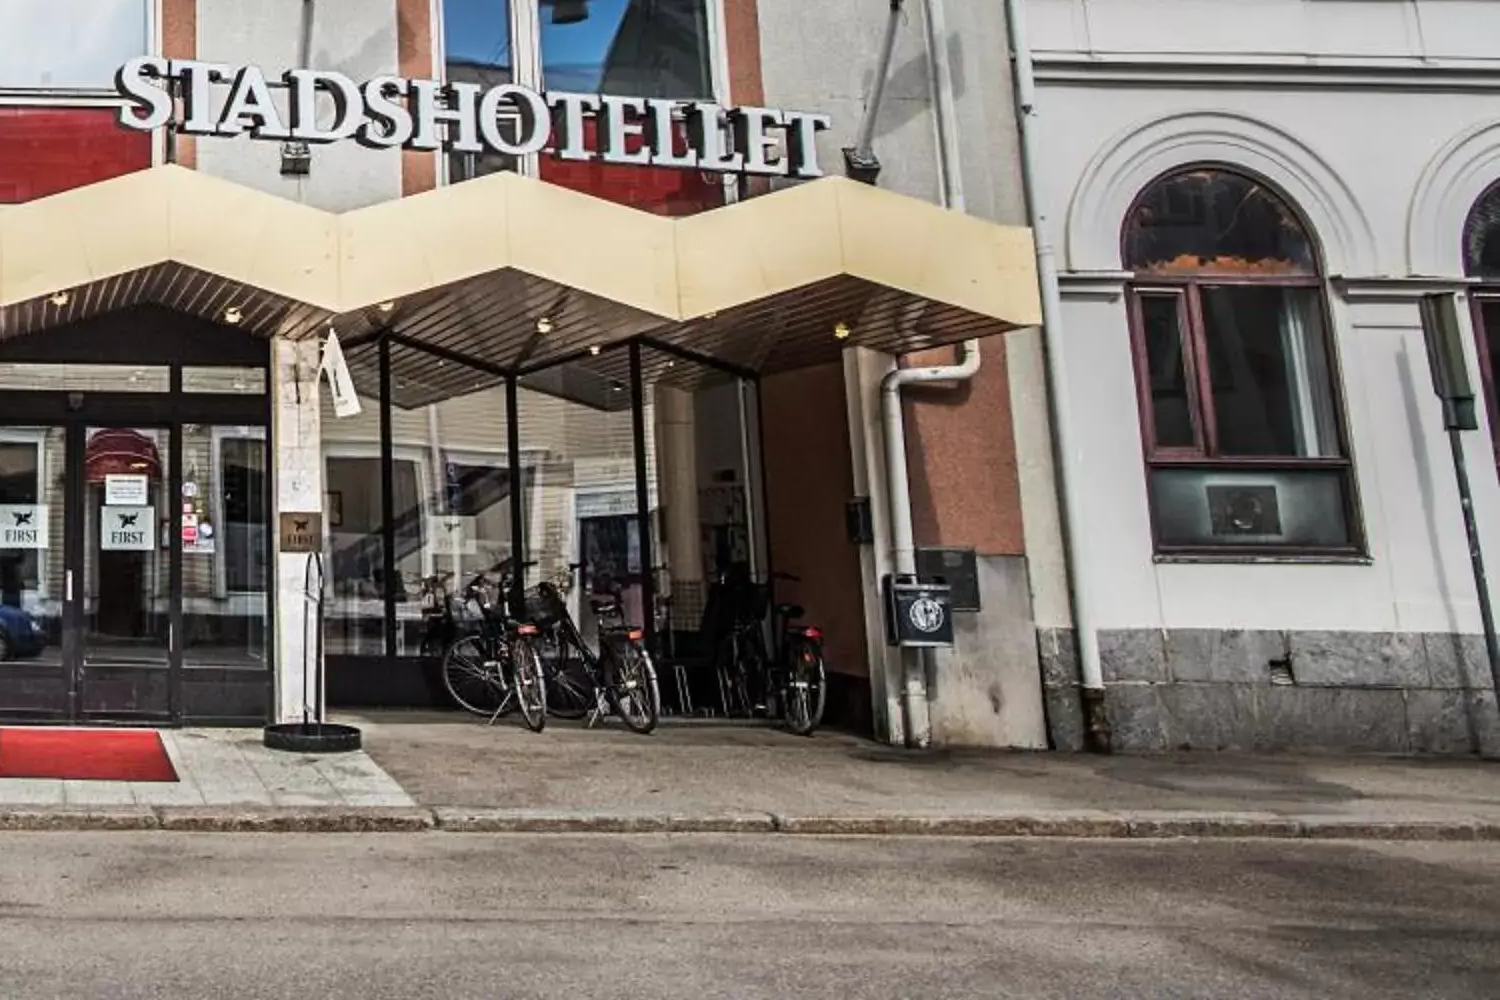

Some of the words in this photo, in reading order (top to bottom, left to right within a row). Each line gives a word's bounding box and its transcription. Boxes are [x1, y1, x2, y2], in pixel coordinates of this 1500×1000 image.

[115, 55, 830, 177] STADSHOTELLET
[5, 529, 39, 542] FIRST
[111, 531, 146, 544] FIRST
